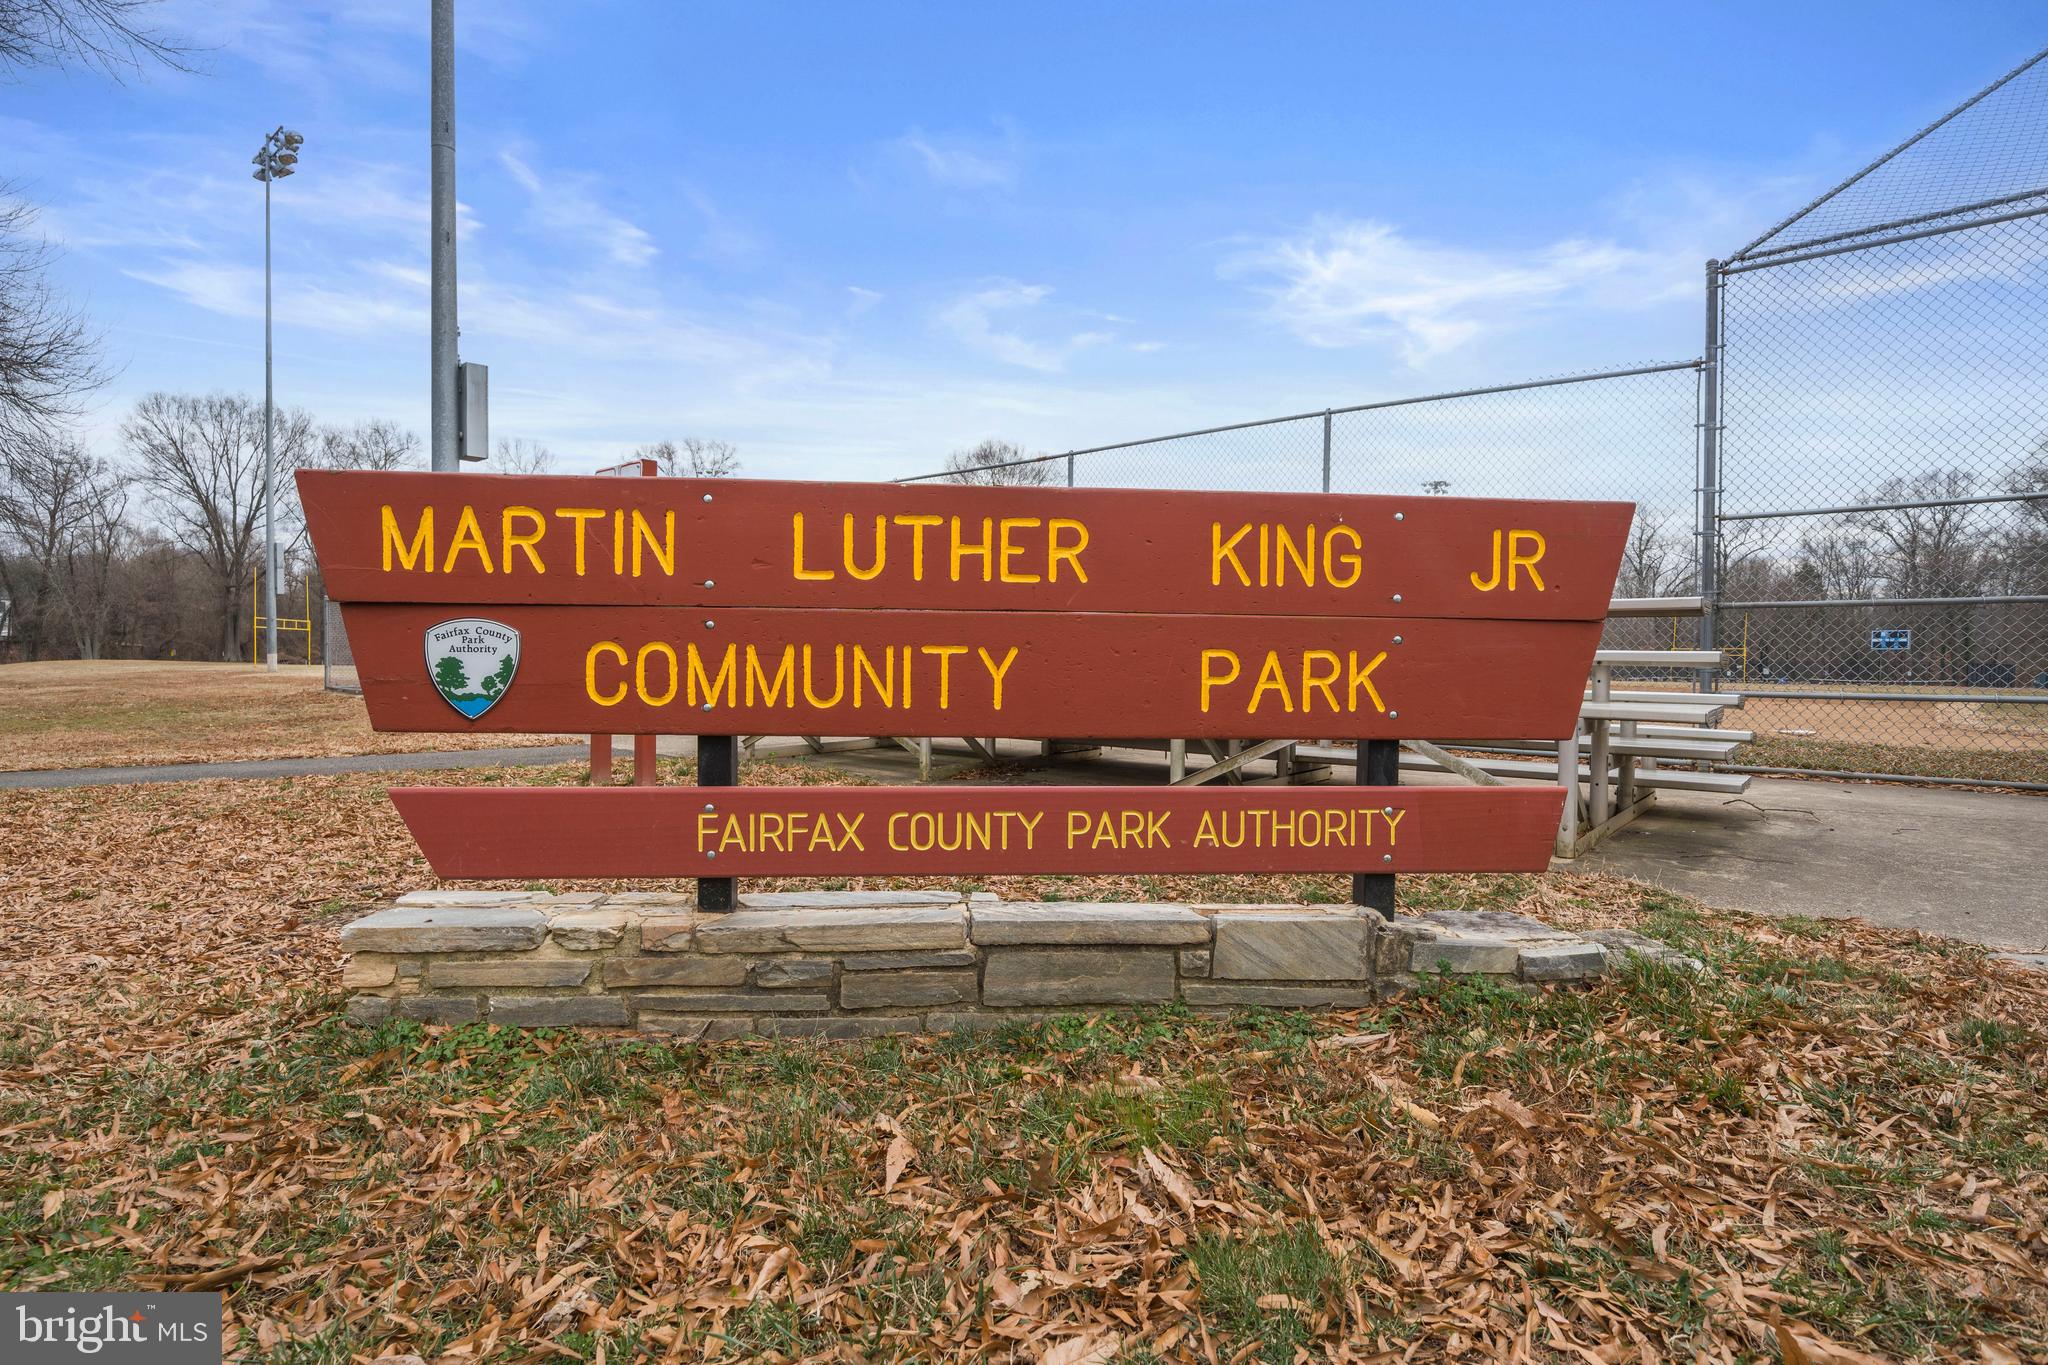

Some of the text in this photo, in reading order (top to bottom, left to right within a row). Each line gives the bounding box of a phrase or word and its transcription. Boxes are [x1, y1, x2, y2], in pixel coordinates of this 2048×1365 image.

[380, 505, 1546, 592] MARTIN LUTHER KING JR
[433, 626, 513, 644] Fairfax County
[449, 644, 498, 656] Authority
[461, 635, 485, 644] Park
[585, 640, 1388, 714] COMMUNITY PARK
[696, 807, 1405, 853] FAIRFAX COUNTY PARK AUTHORITY
